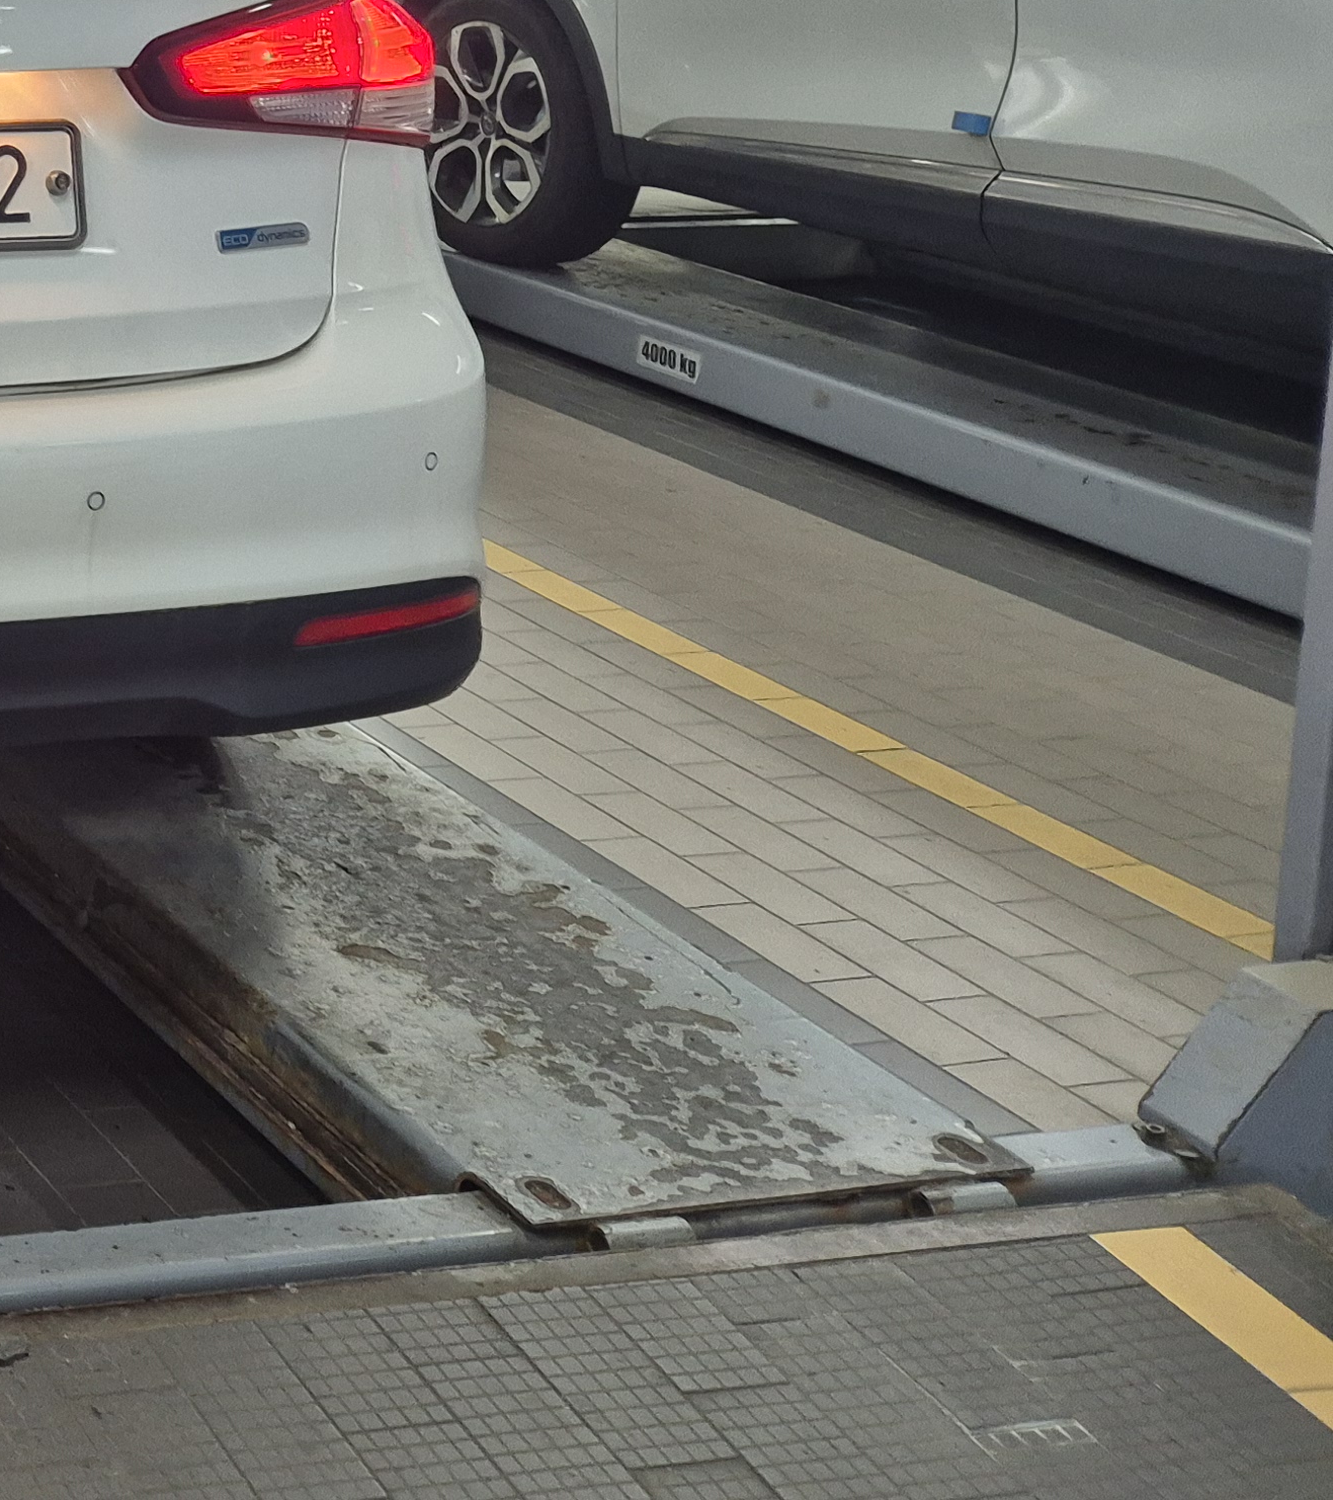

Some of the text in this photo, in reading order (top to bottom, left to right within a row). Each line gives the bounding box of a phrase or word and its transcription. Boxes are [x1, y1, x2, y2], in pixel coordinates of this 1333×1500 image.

[222, 228, 307, 247] ECO dynamics
[641, 340, 697, 379] 4000 kg
